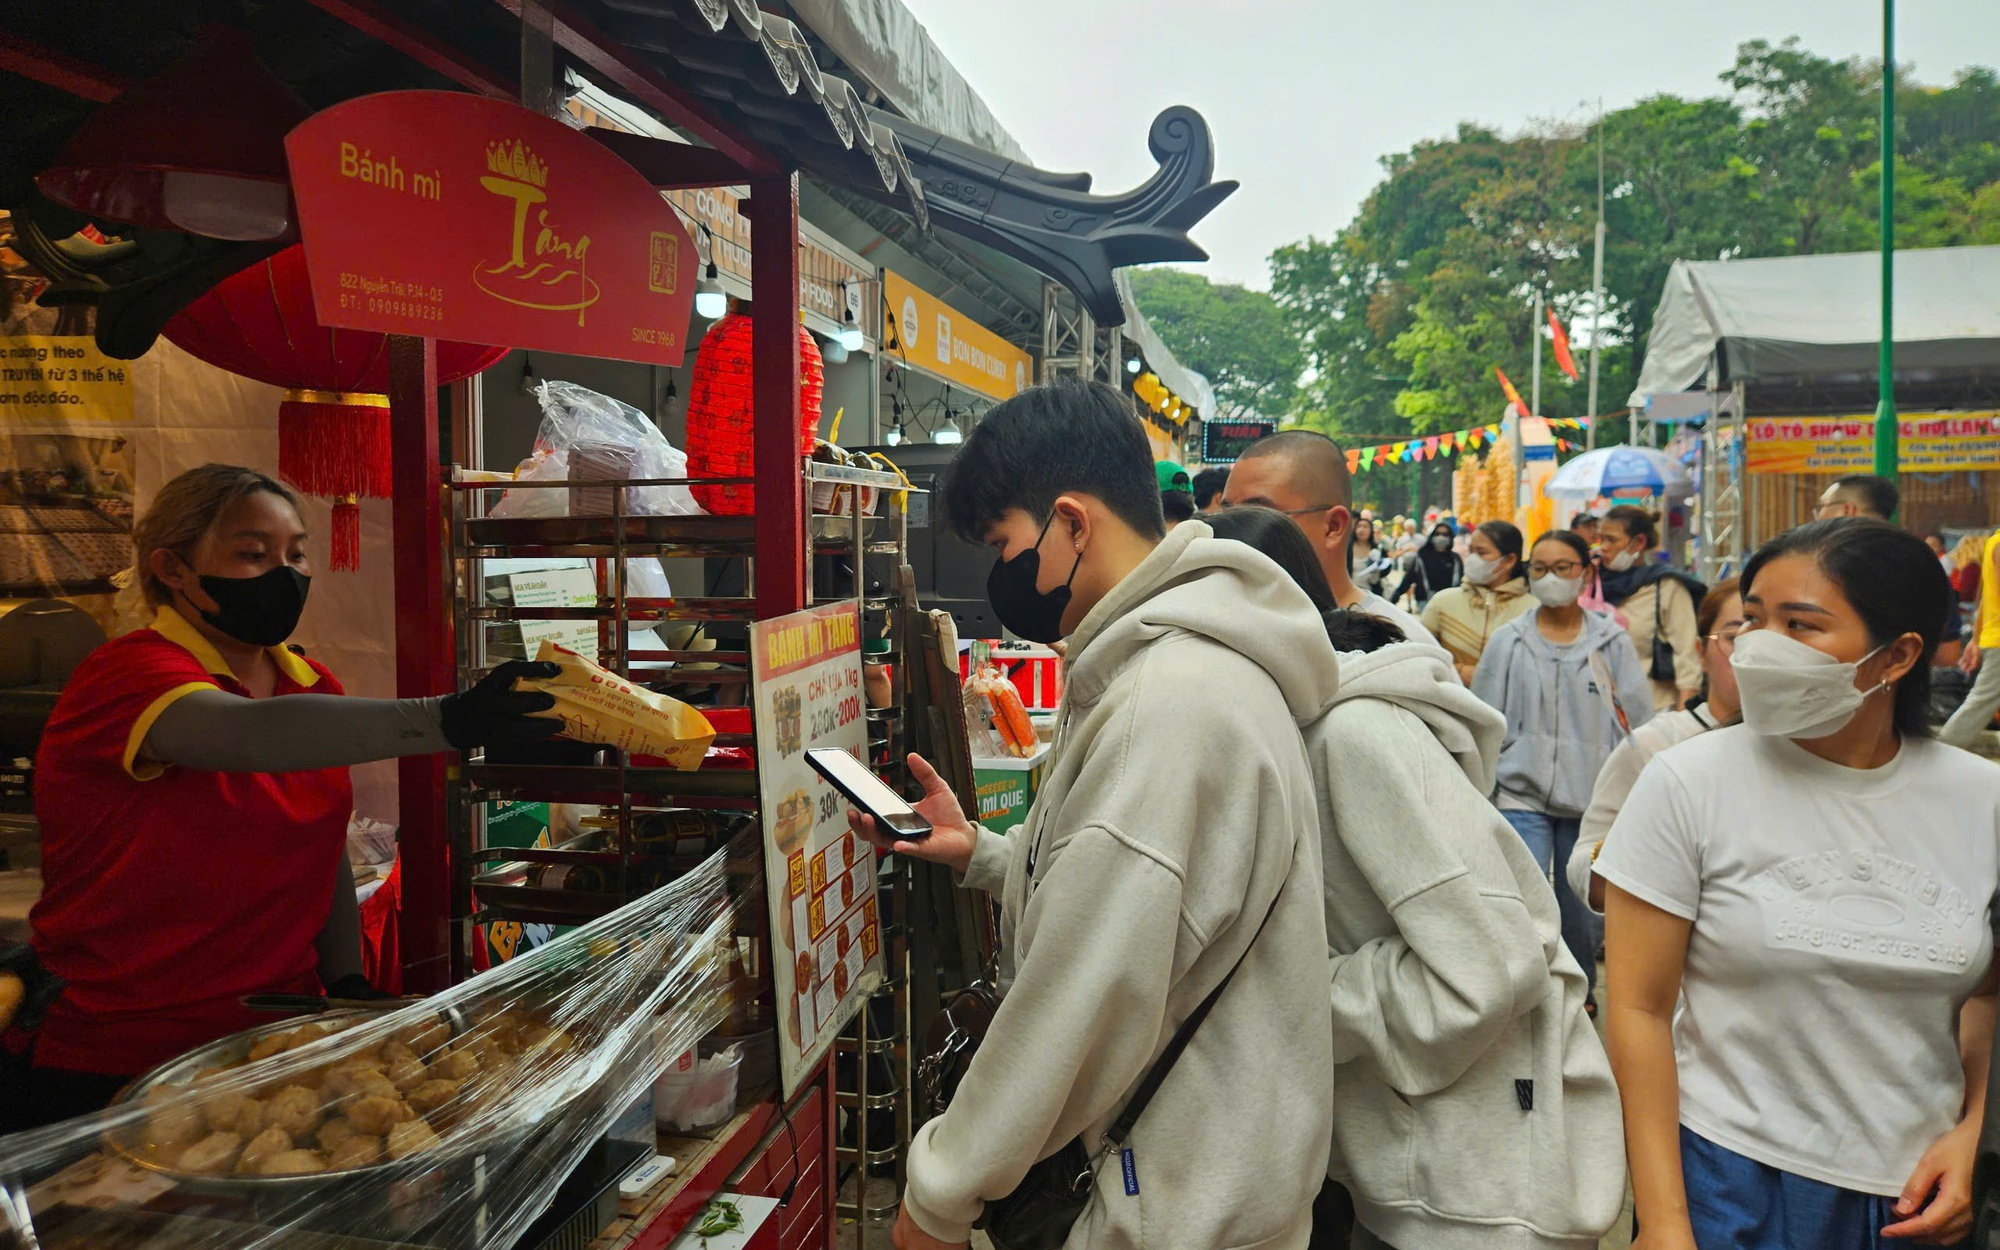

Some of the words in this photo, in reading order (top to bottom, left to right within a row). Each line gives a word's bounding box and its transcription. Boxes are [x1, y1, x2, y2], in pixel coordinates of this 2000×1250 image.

[340, 142, 404, 192] Bánh
[414, 170, 441, 202] mì
[696, 190, 734, 228] CÔNG
[340, 272, 358, 288] 822
[810, 283, 834, 308] FOOD
[632, 327, 656, 344] SINCE
[657, 329, 676, 347] 1968
[53, 346, 86, 358] theo
[953, 336, 970, 365] BON
[971, 346, 987, 373] BON
[987, 354, 1007, 382] CURRY
[48, 367, 66, 381] từ
[68, 368, 78, 382] 3
[82, 366, 106, 382] thế
[108, 368, 125, 386] hệ
[1755, 421, 1777, 439] LÔ
[1781, 421, 1803, 439] TÔ
[1000, 789, 1024, 809] QUE
